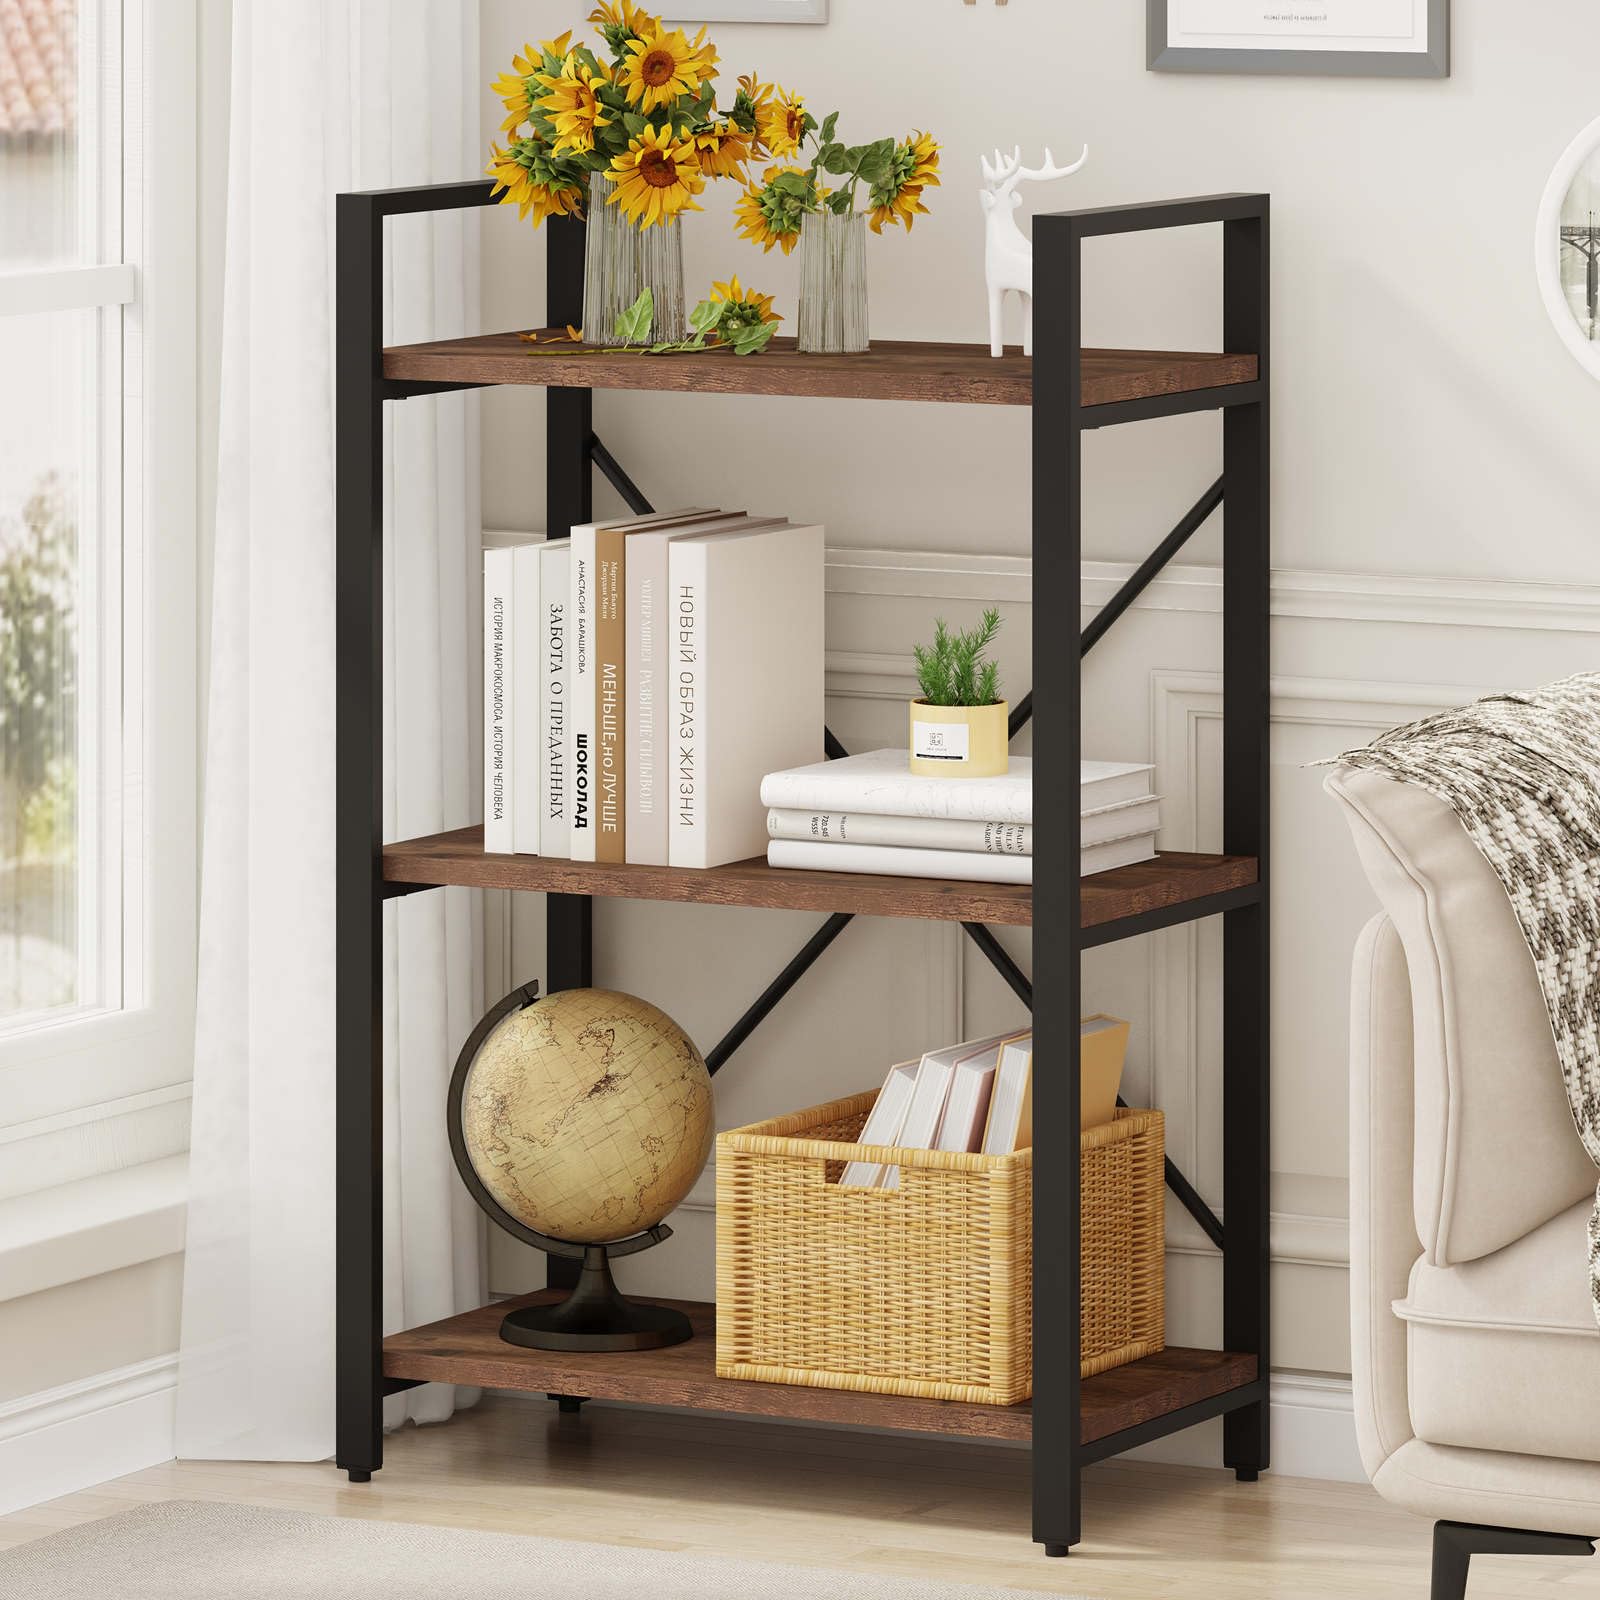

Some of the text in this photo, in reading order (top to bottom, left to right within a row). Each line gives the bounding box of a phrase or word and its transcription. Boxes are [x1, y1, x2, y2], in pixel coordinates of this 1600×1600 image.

[494, 597, 503, 641] ИСТОРИЯ
[578, 560, 586, 674] АНАСТАСИЯ БАРАШКОВА
[548, 603, 564, 819] ЗАБОТА О ПРЕДАННЫХ
[679, 586, 697, 826] НОВЫЙ ОБРАЗ ЖИЗНИ
[494, 726, 503, 770] ИСТОРИЯ
[575, 733, 588, 829] ШОКОЛАД
[494, 772, 503, 820] ЧЕЛОВЕКА
[602, 770, 617, 833] ЛУЧШЕ
